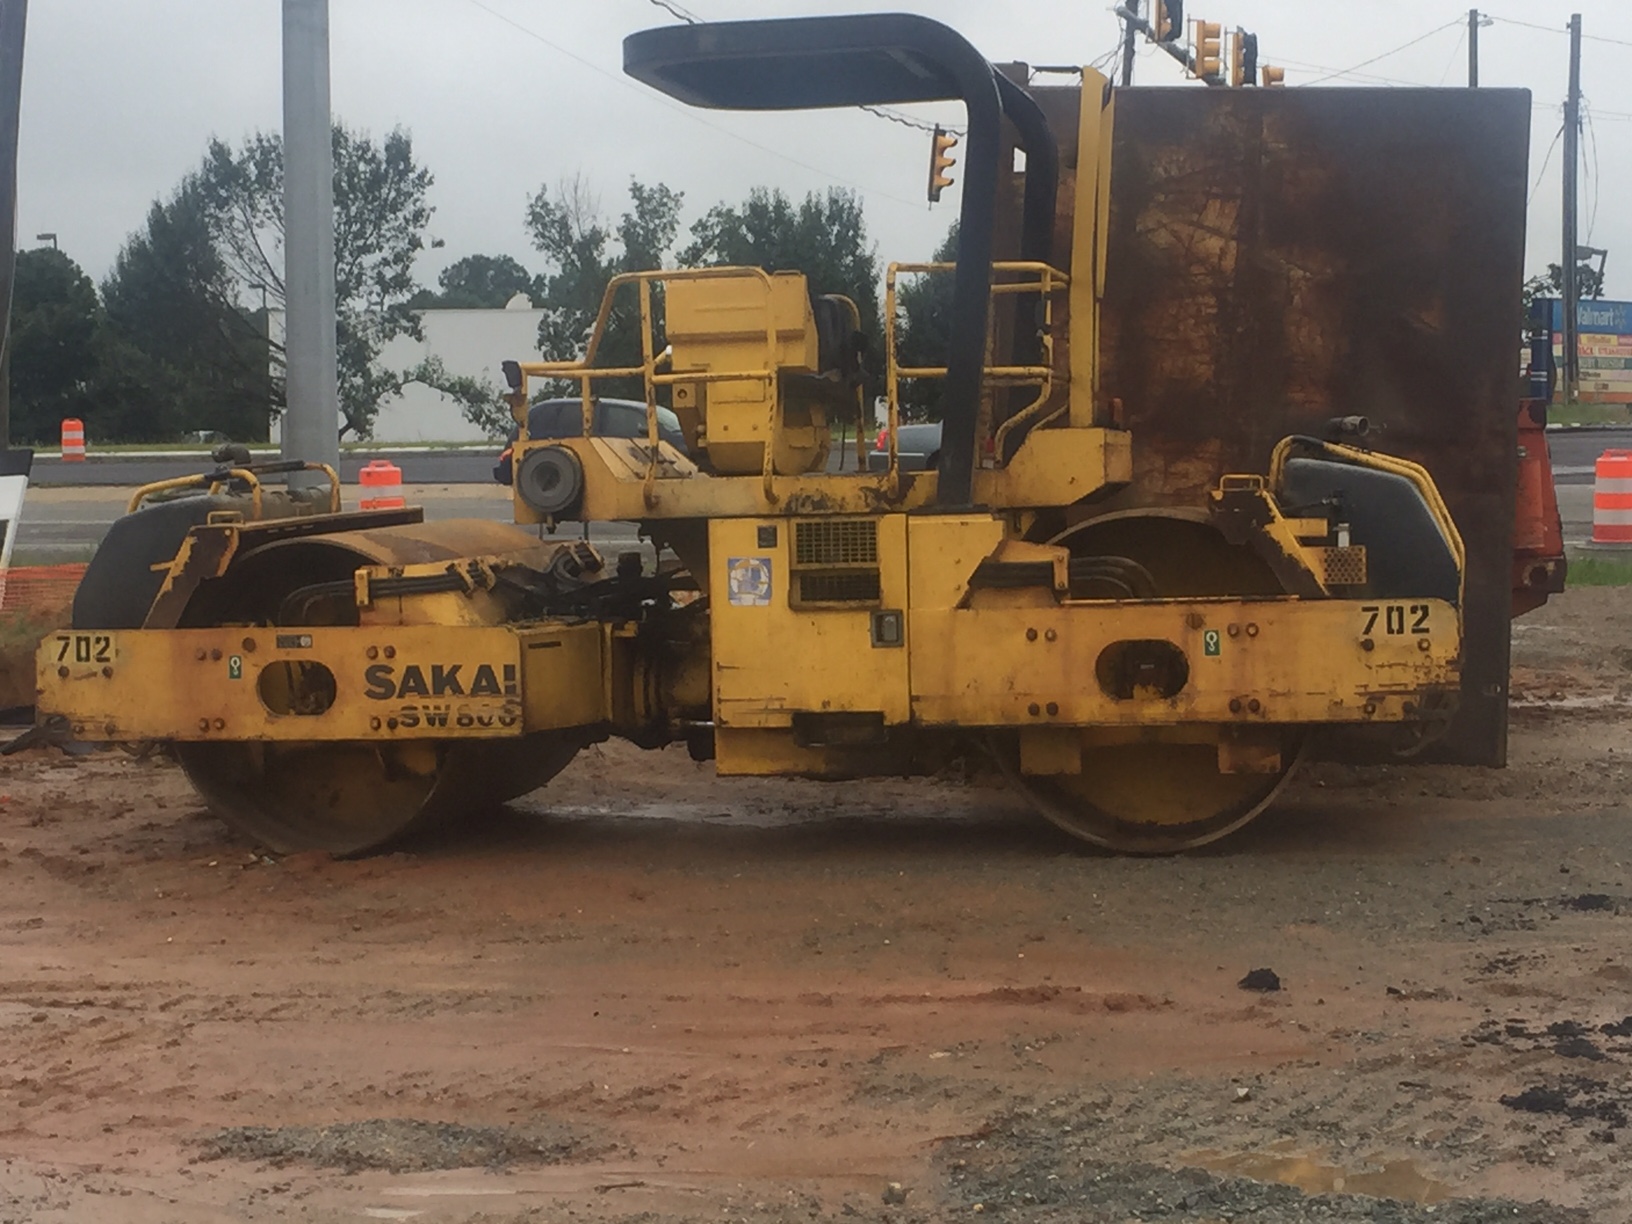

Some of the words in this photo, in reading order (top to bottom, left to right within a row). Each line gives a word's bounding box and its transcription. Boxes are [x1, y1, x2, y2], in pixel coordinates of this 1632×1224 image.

[1361, 605, 1430, 635] 702
[56, 636, 111, 662] 702
[364, 664, 517, 700] SAKAI
